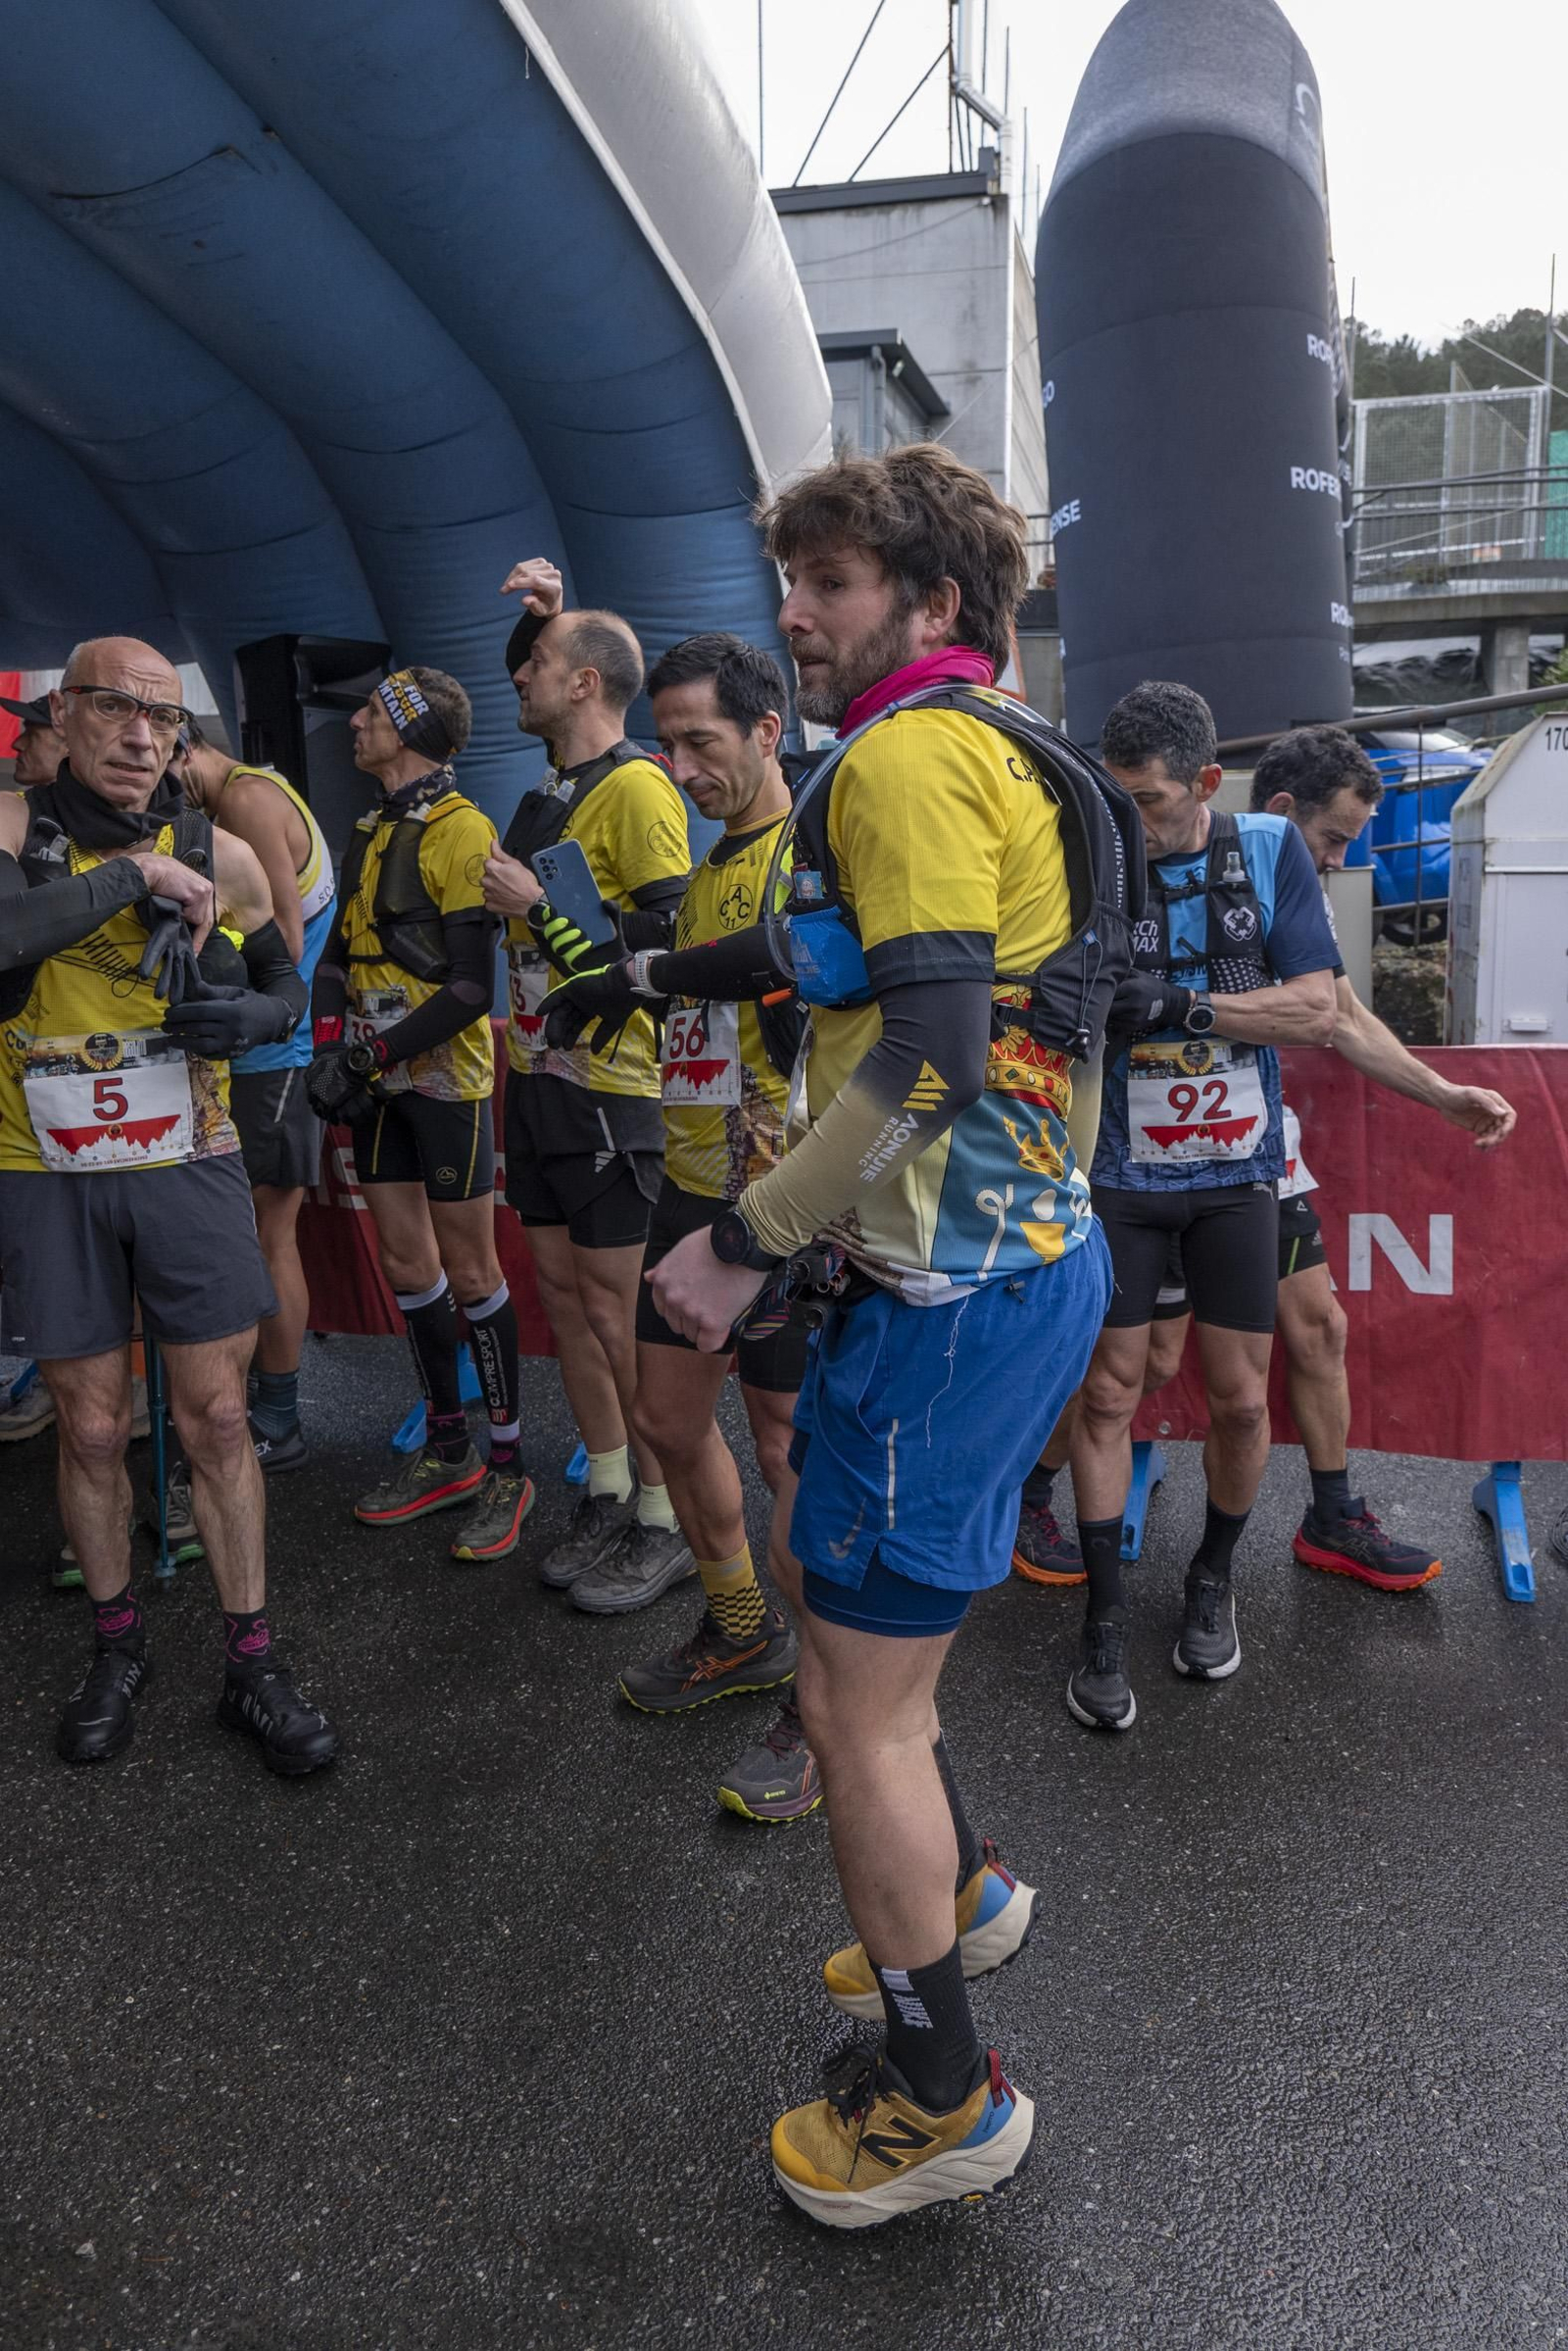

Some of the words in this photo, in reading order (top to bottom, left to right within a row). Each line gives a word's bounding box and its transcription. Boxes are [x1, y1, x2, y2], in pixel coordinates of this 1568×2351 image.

[404, 684, 430, 716] FOR
[668, 1012, 707, 1060] 56
[92, 1077, 129, 1122] 5
[1167, 1079, 1233, 1123] 92
[858, 1115, 900, 1167] RUNNING
[892, 1992, 934, 2030] NIKE
